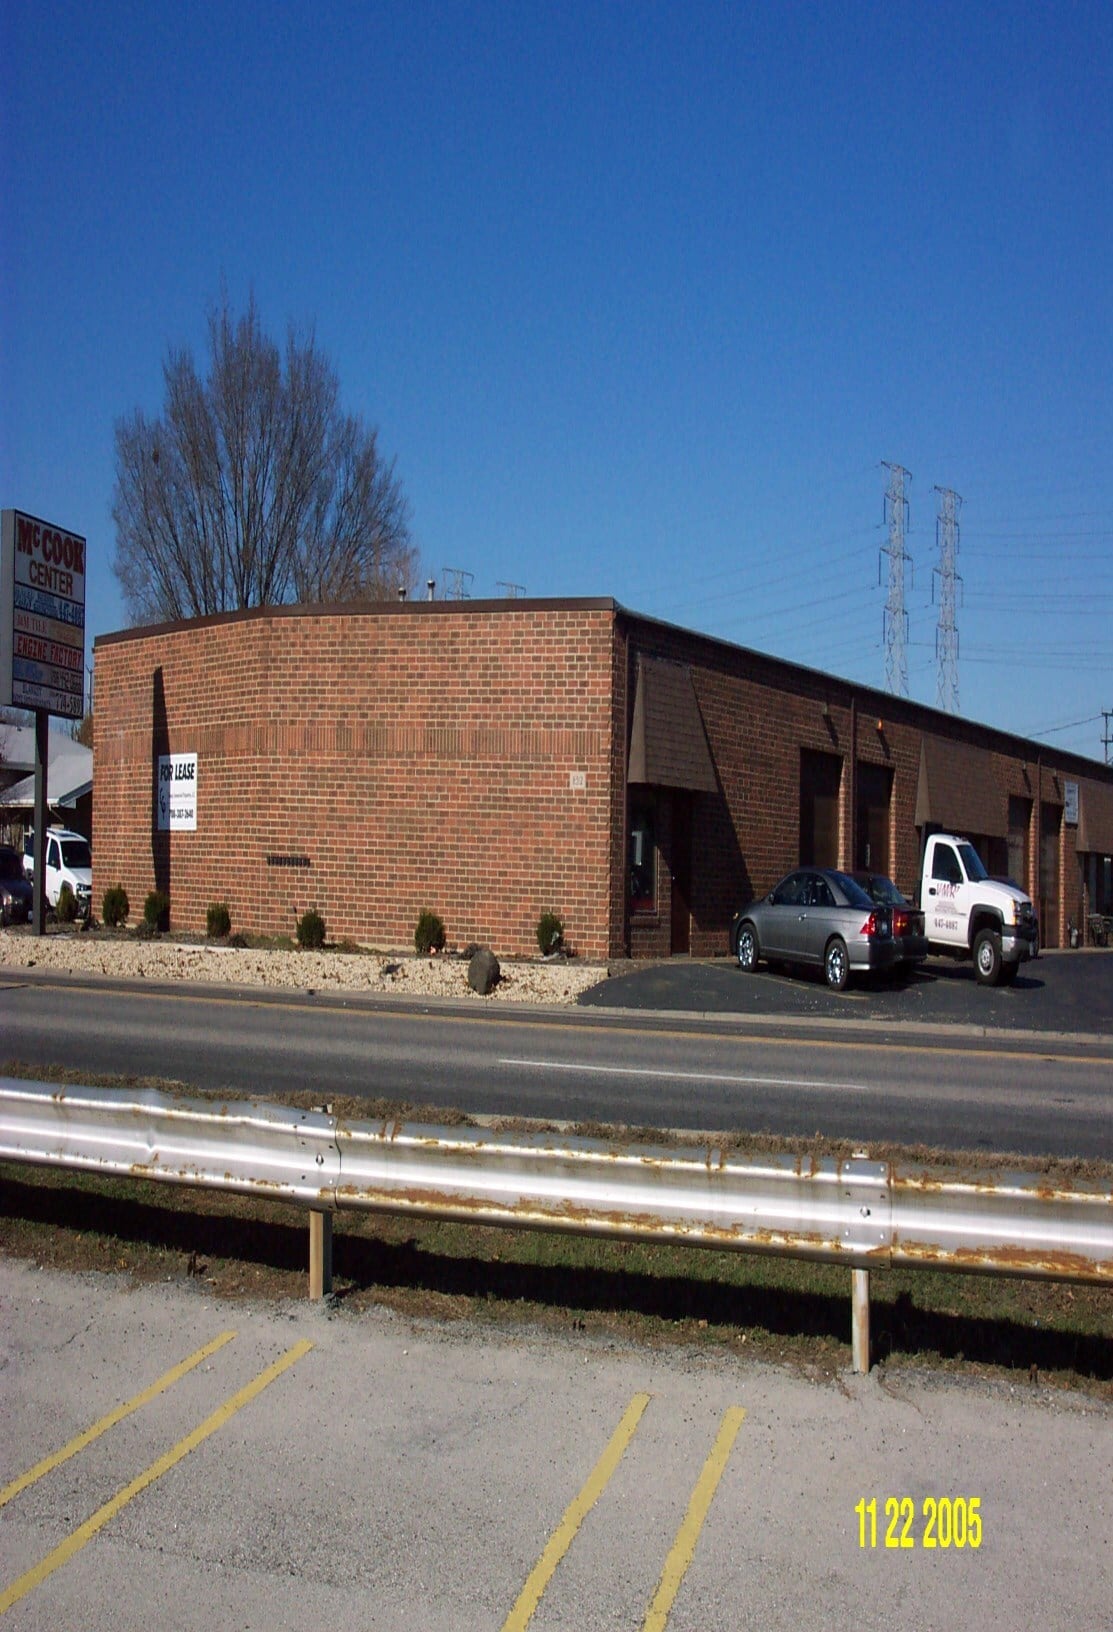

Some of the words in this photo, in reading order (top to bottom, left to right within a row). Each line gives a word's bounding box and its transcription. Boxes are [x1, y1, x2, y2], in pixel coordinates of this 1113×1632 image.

[29, 560, 73, 596] CENTER
[17, 634, 47, 661] ENGINE
[50, 643, 82, 670] FACTORY
[160, 764, 173, 781] FOR
[175, 763, 195, 780] LEASE
